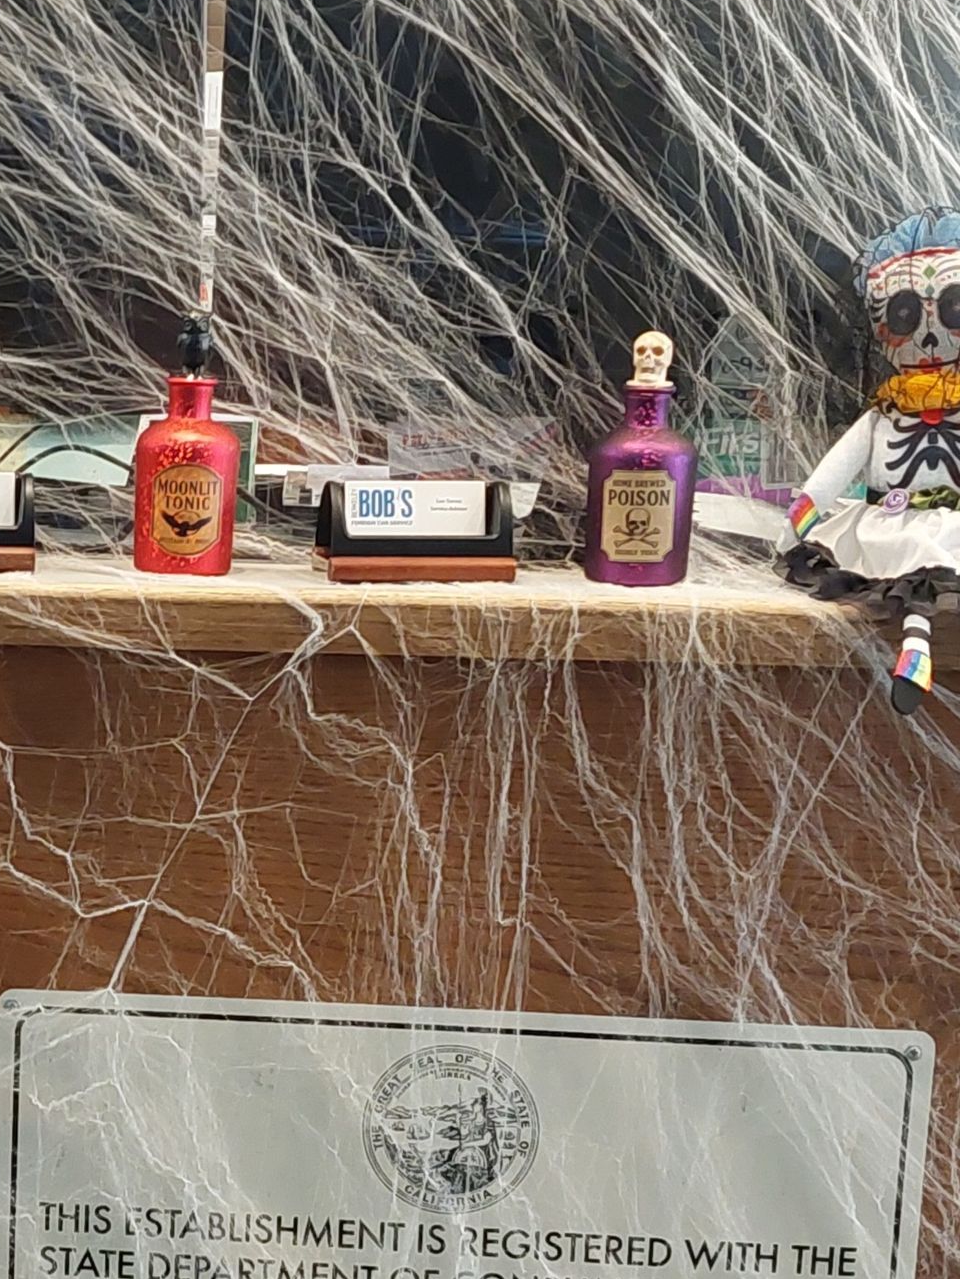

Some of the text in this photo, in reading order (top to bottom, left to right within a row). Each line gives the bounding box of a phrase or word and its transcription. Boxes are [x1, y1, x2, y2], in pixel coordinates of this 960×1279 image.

[158, 480, 218, 496] MOONLIT
[165, 496, 210, 510] TONIC
[358, 489, 413, 518] BOB'S
[607, 489, 671, 507] POISON
[38, 1201, 858, 1277] THIS ESTABLISHMENT IS REGISTERED WITH THE
